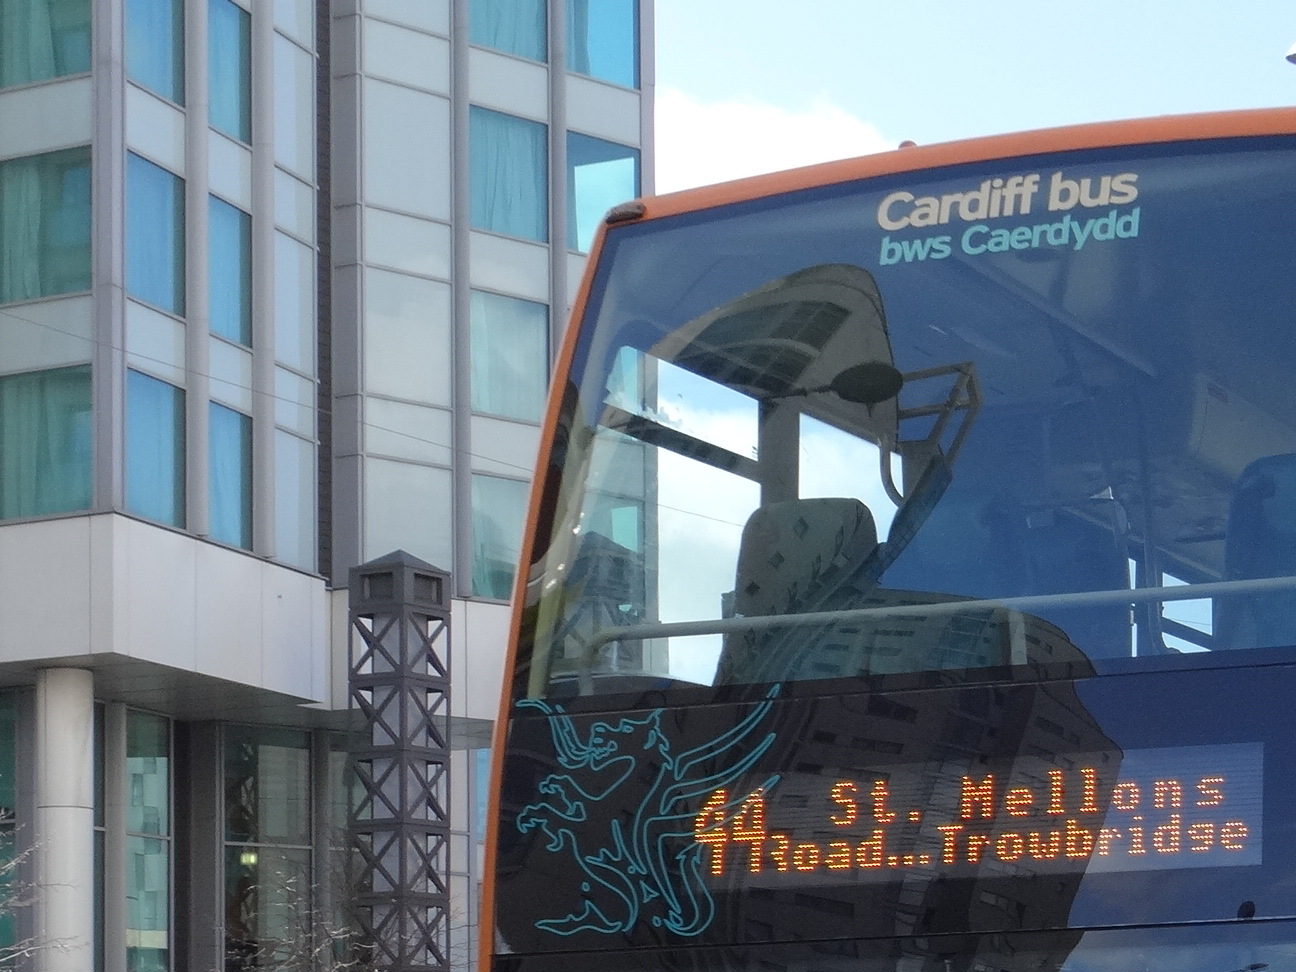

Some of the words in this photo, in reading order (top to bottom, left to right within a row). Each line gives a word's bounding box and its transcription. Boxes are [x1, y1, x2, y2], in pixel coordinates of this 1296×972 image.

[877, 174, 1040, 231] Cardiff
[1048, 172, 1138, 211] bus
[879, 235, 952, 266] bws
[961, 207, 1141, 255] Caerdydd
[694, 788, 766, 875] 44
[831, 780, 920, 825] St.
[961, 768, 1224, 819] Mellons
